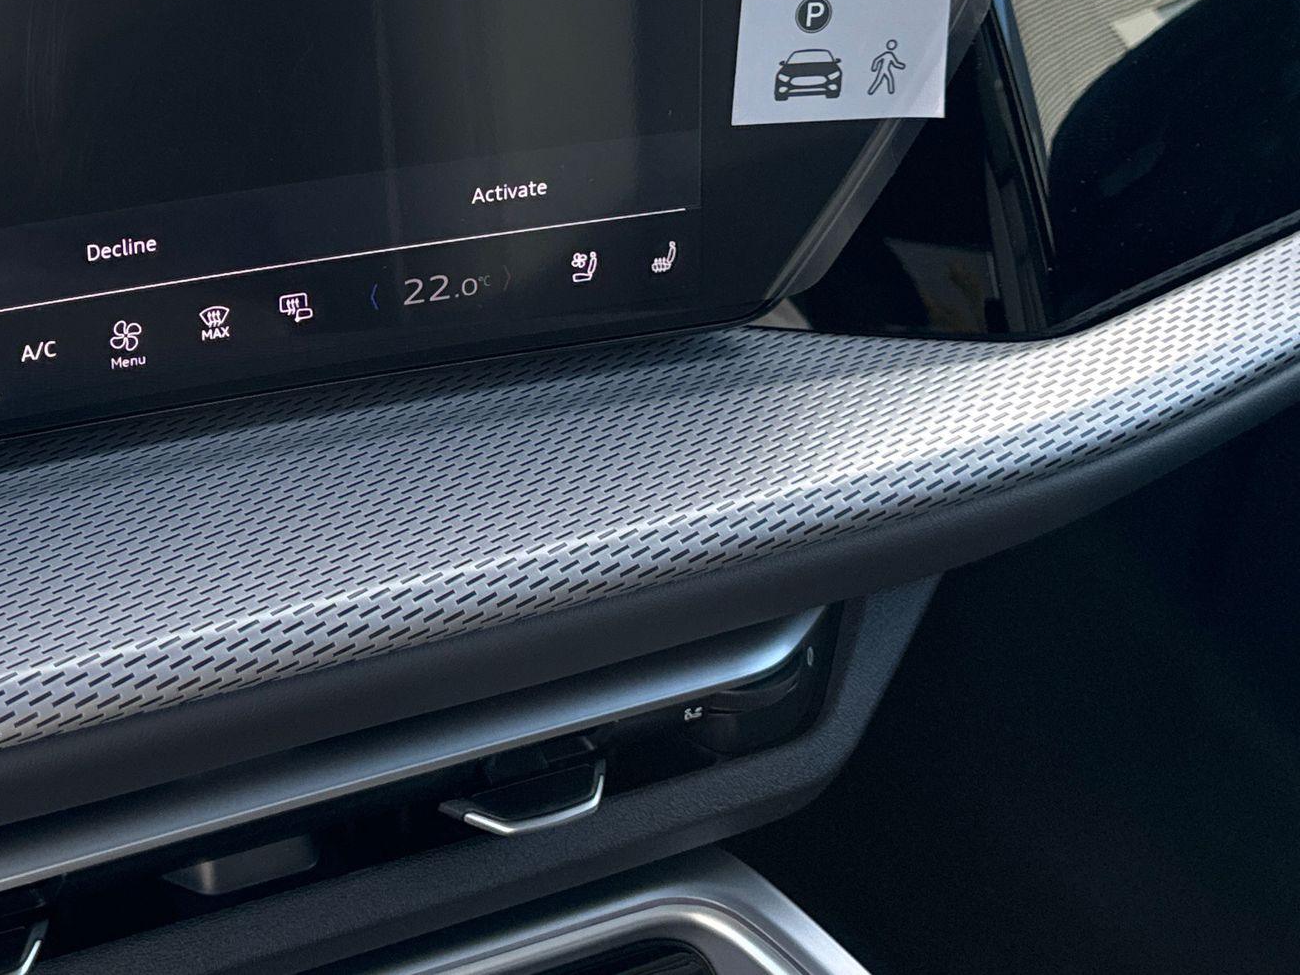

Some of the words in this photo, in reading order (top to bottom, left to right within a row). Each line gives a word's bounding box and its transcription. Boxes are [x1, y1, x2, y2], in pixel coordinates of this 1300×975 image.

[807, 2, 825, 27] P
[471, 178, 548, 206] Activate
[86, 233, 158, 263] Decline
[201, 326, 230, 341] MAX
[21, 341, 57, 362] A/C
[110, 355, 146, 369] Menu
